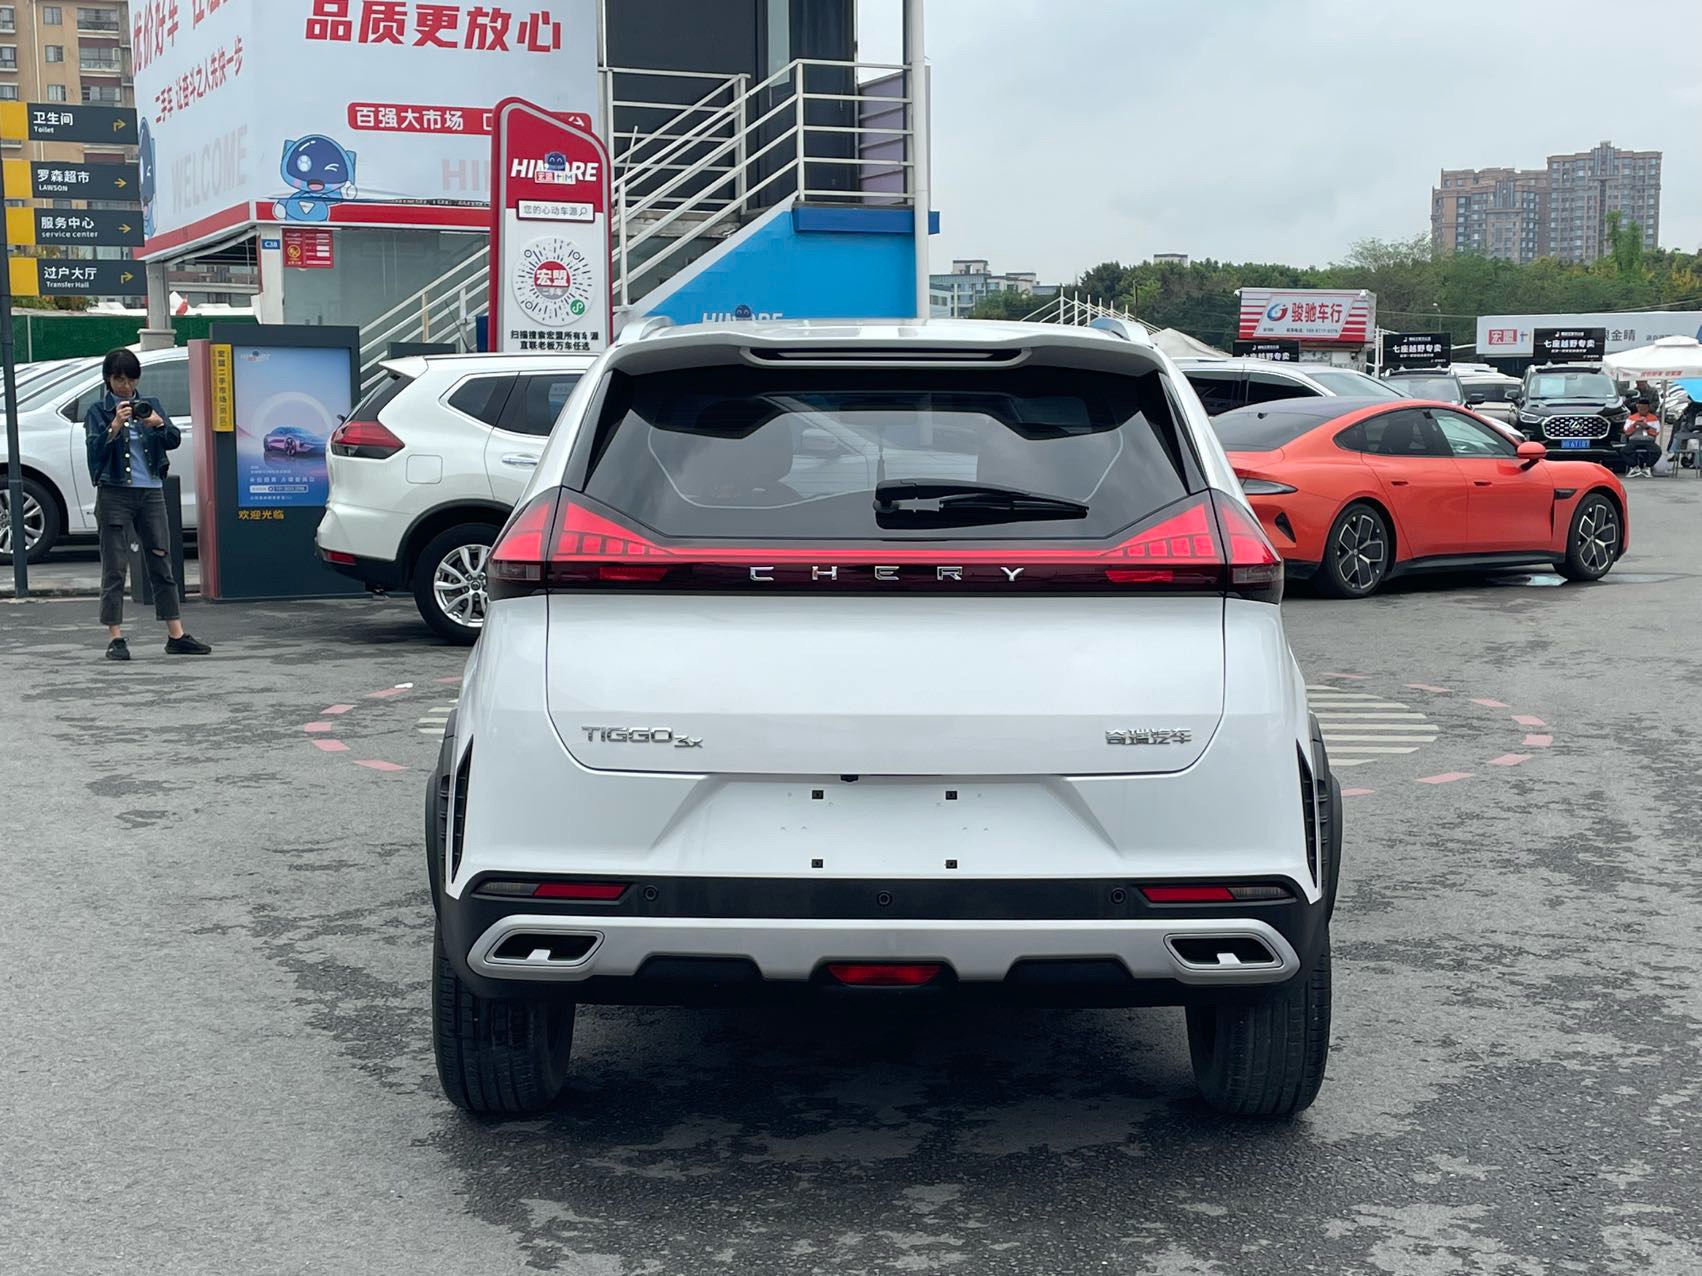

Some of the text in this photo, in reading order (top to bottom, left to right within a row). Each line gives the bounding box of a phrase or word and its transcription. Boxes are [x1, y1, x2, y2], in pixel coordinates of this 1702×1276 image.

[305, 0, 562, 52] 品质更放心
[33, 112, 74, 125] 卫生间
[355, 106, 464, 130] 百强大市场
[34, 125, 55, 134] Toilet
[37, 169, 90, 184] 罗森超市
[523, 205, 578, 216] 您的心动车源
[41, 216, 95, 229] 服务中心
[72, 230, 98, 238] center
[44, 267, 97, 280] 过户大厅
[536, 269, 569, 287] 宏盟
[46, 281, 90, 289] Transfer Hall
[1291, 302, 1342, 323] 骏驰车行
[238, 510, 285, 520] 欢迎光临
[750, 565, 1024, 581] CHERY
[1105, 728, 1192, 745] 奇瑞汽车
